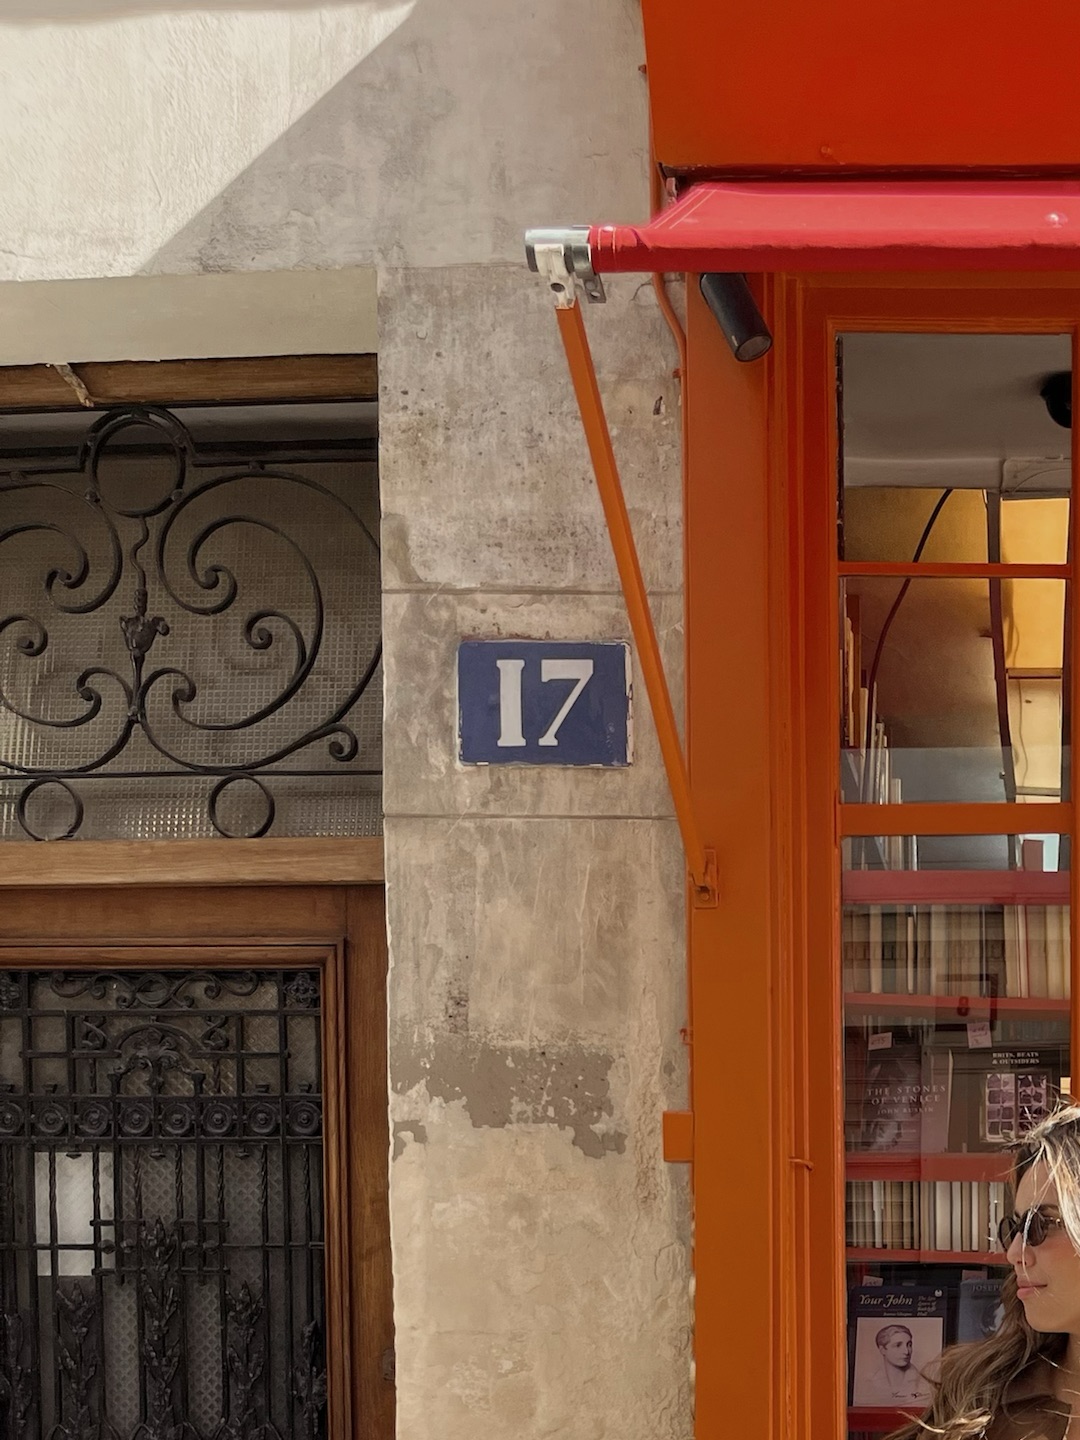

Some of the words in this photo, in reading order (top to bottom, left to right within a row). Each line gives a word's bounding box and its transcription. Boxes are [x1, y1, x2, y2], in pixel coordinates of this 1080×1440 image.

[496, 659, 594, 746] 17
[867, 1088, 890, 1096] THE
[897, 1085, 946, 1094] STONES
[871, 1097, 886, 1106] OF
[888, 1094, 941, 1104] VENICE
[902, 1106, 934, 1114] RUSKIN
[859, 1294, 883, 1305] Your
[883, 1294, 913, 1308] John
